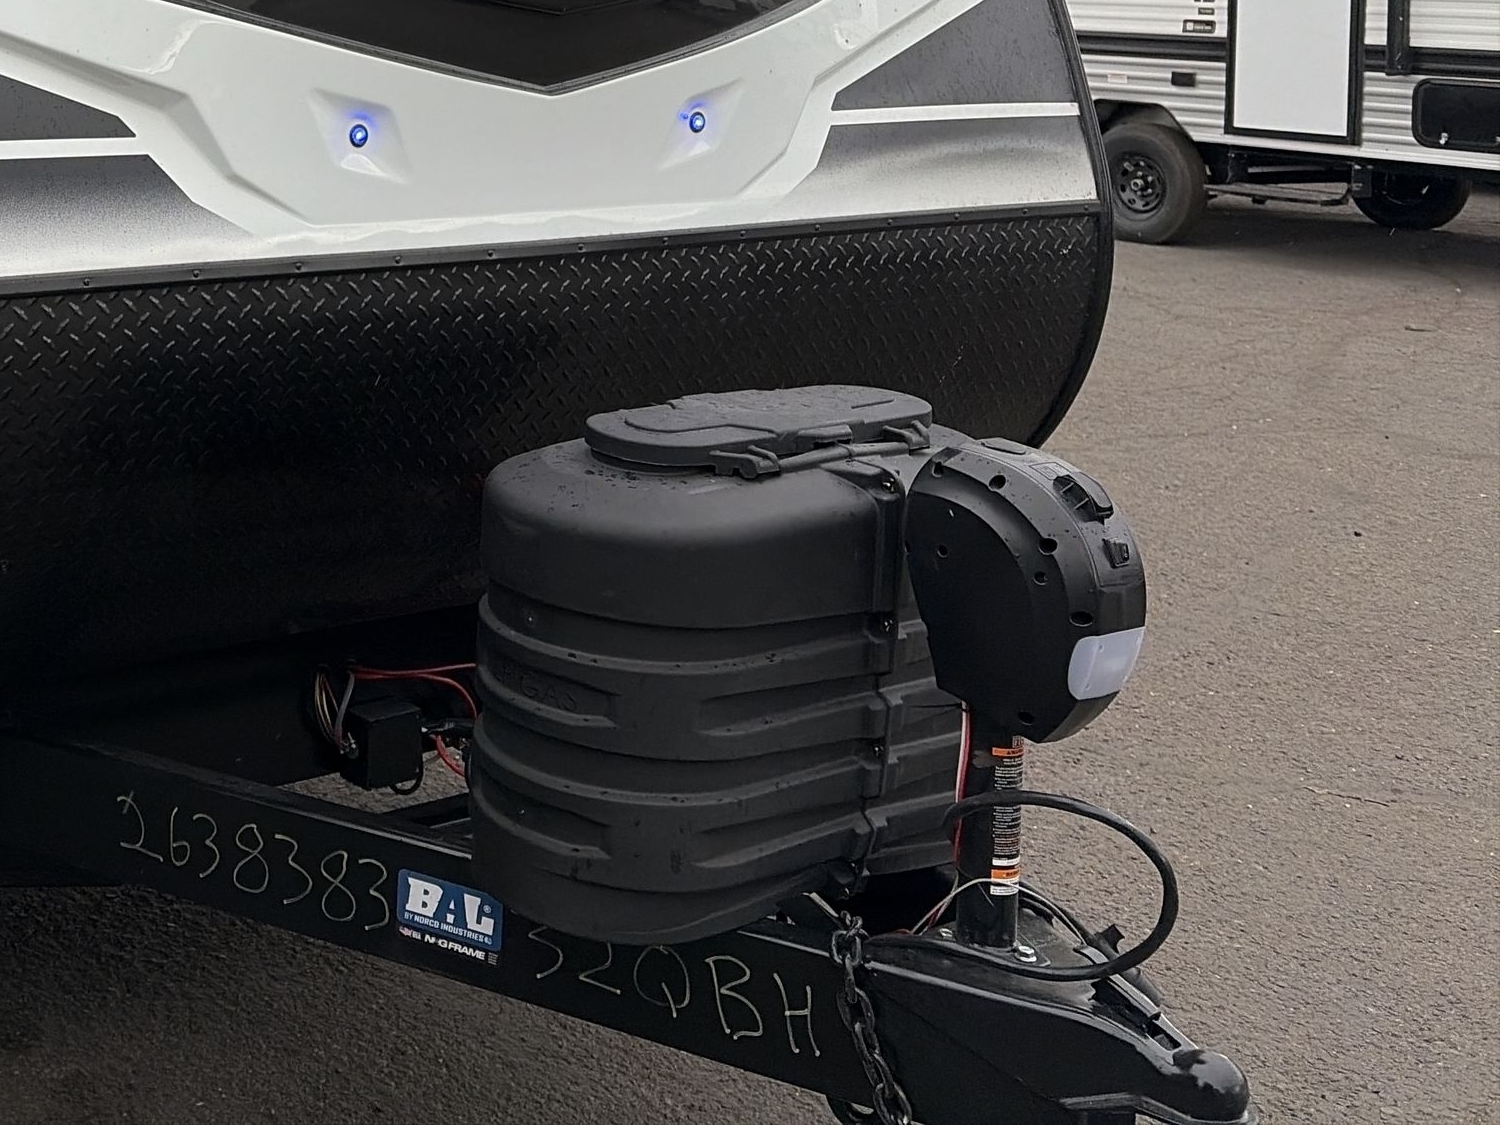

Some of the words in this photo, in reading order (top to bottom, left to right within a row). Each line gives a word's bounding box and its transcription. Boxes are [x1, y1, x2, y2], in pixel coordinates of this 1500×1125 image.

[117, 790, 390, 931] 2638383
[404, 911, 414, 920] BY
[414, 915, 440, 929] NORCO
[441, 922, 485, 942] INDUSTRIES
